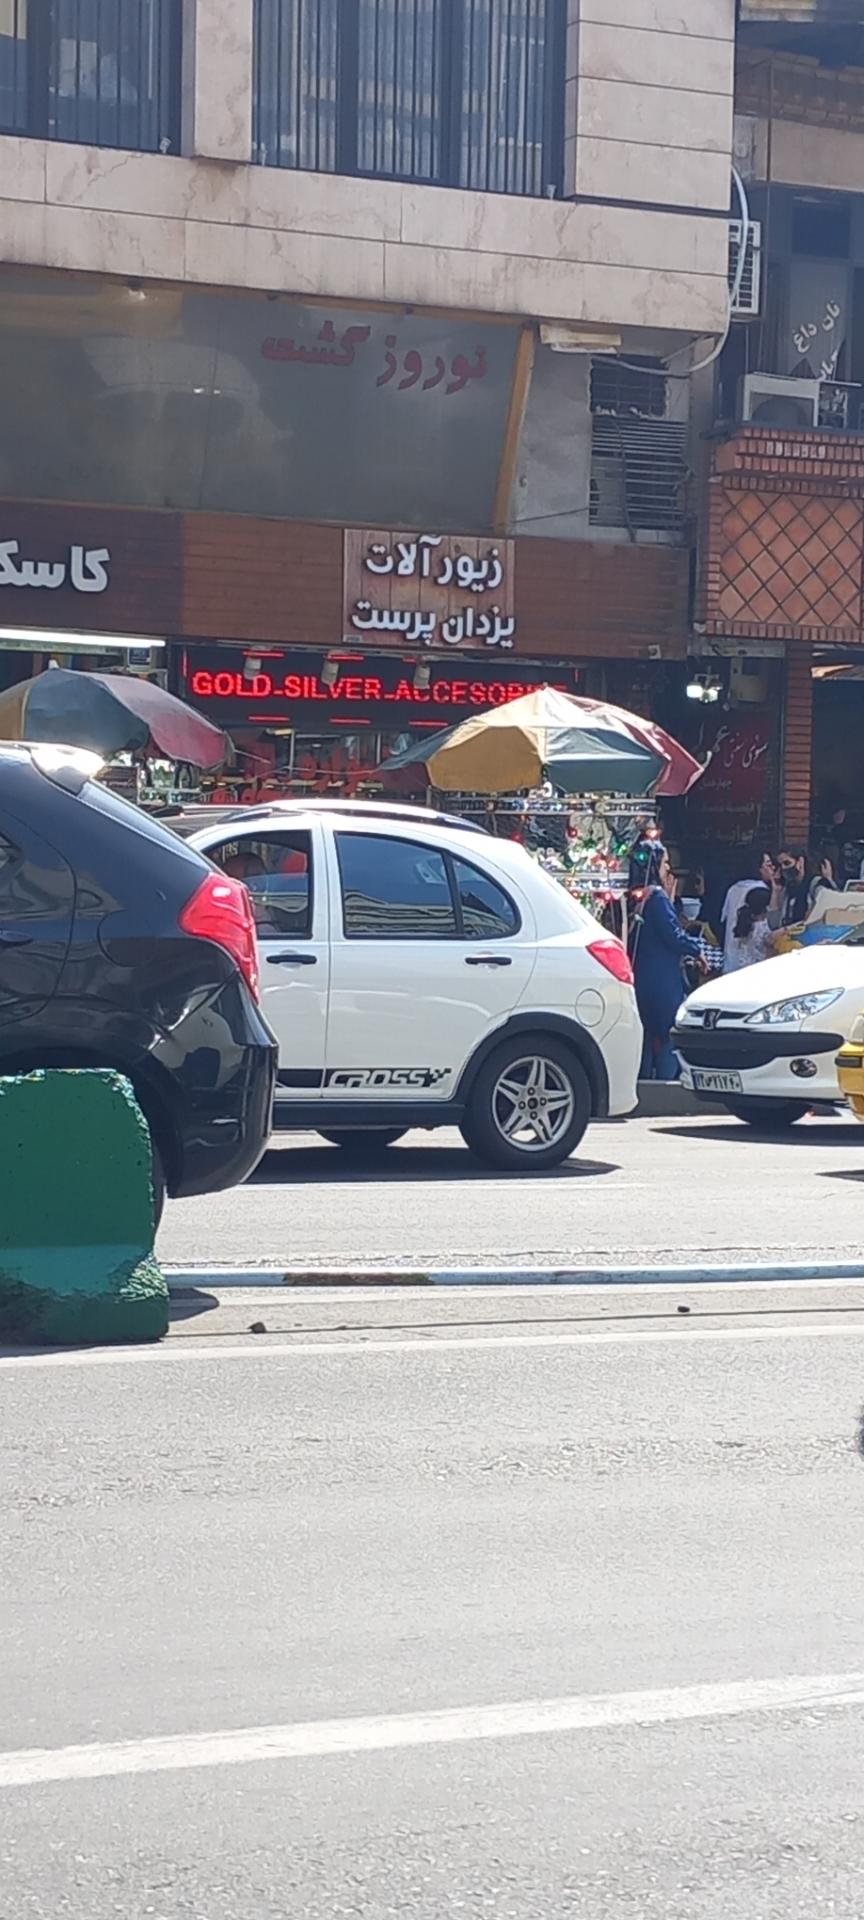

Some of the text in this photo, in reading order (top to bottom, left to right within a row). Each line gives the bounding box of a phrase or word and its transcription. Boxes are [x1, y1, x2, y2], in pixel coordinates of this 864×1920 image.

[375, 334, 488, 396] نوروز
[351, 600, 515, 649] یزدان پرست
[328, 1069, 428, 1088] CROSS
